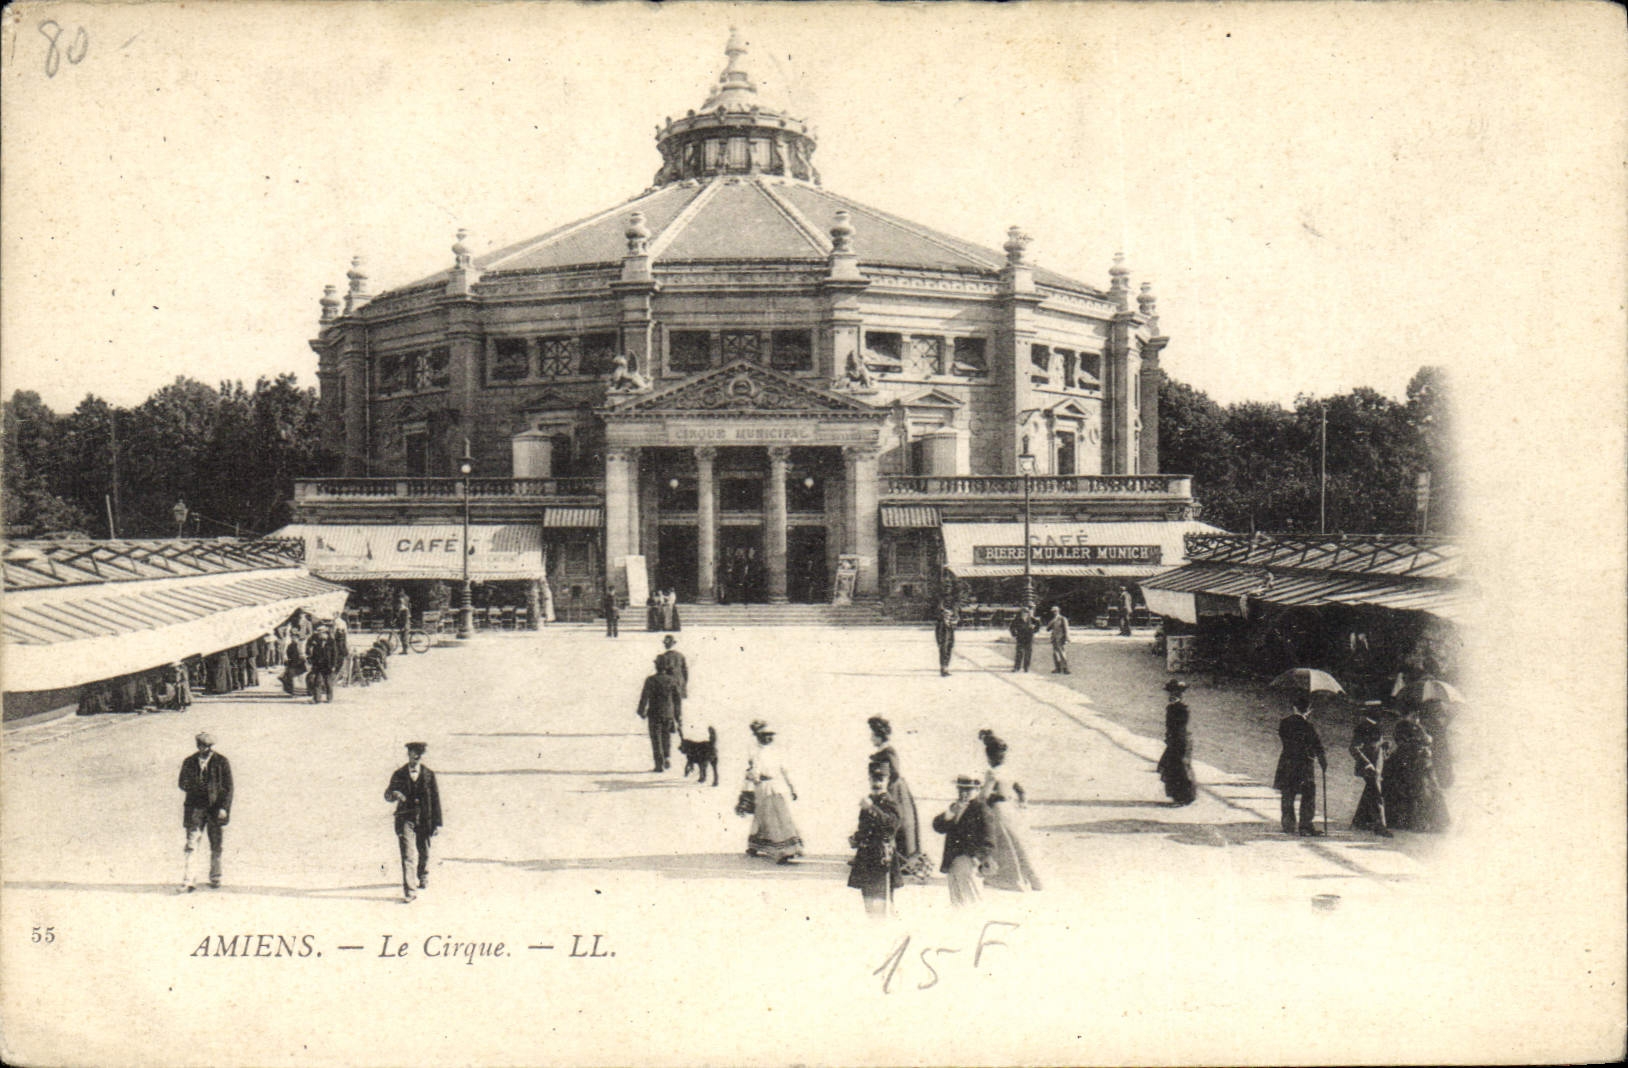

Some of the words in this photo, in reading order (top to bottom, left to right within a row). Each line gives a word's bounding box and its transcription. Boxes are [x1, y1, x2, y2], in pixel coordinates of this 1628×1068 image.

[38, 19, 89, 78] 80
[397, 533, 459, 553] CAFÉ
[1096, 546, 1150, 559] MUNICH
